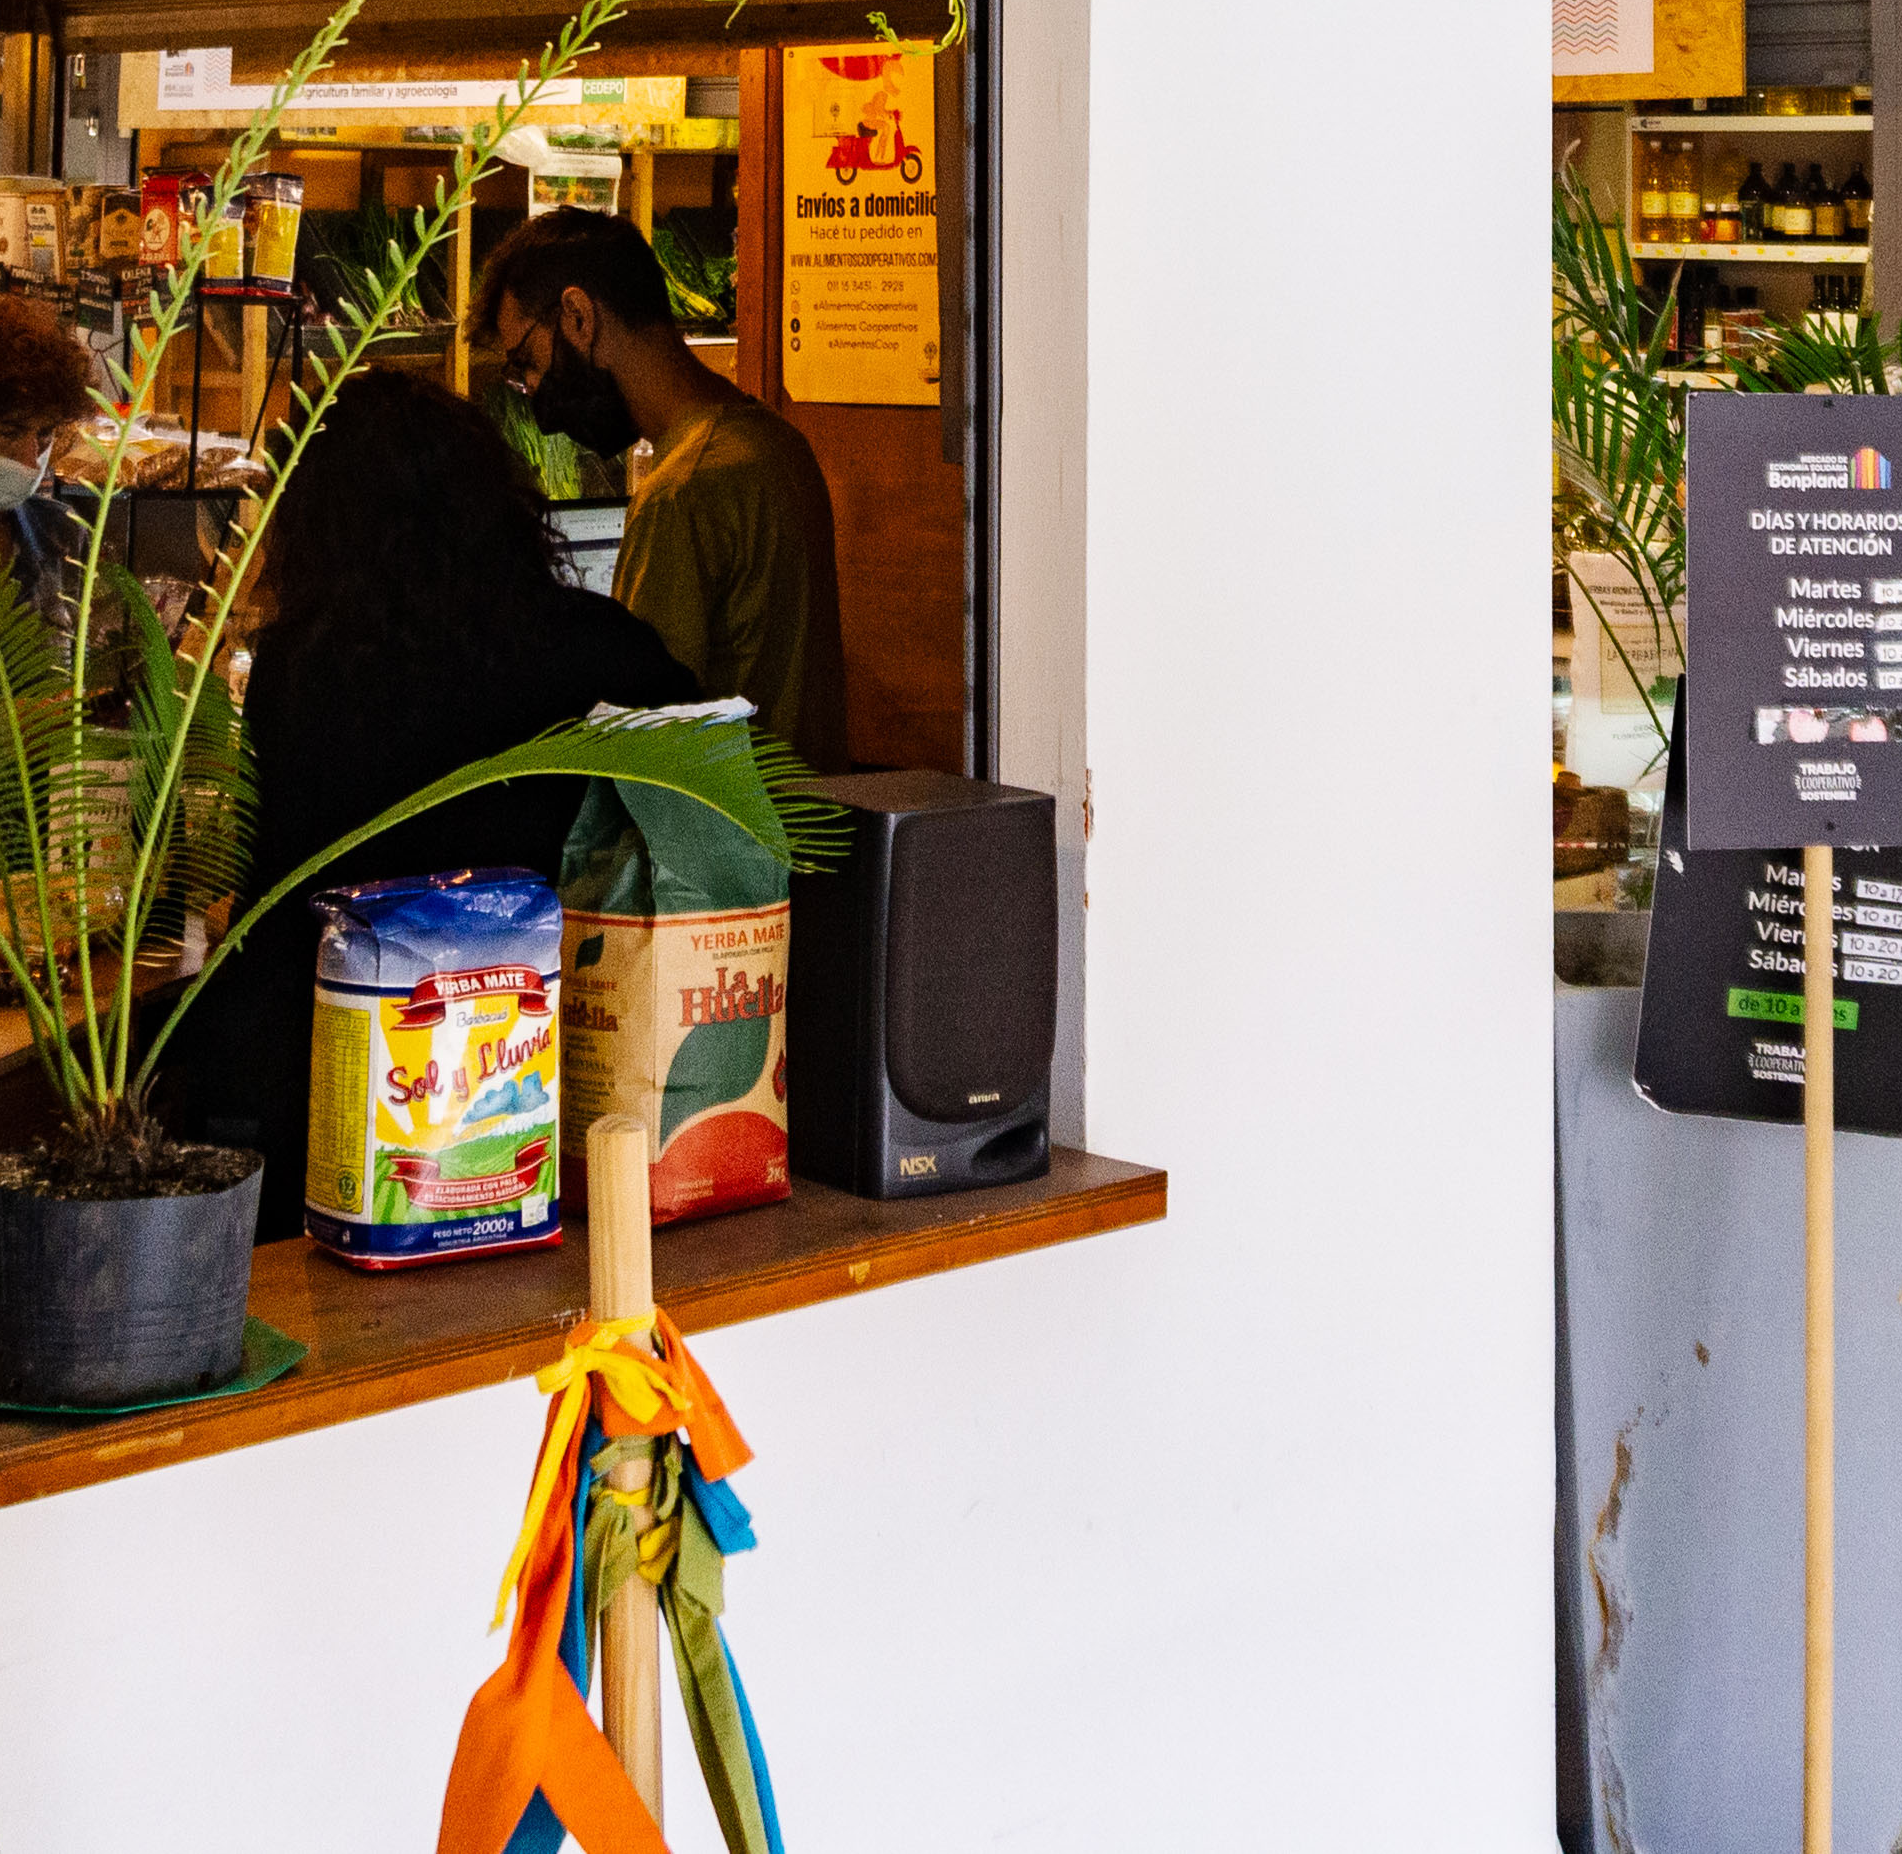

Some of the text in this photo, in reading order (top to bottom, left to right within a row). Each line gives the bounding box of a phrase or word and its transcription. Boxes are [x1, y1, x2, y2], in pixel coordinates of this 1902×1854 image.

[351, 84, 383, 98] familiar
[387, 87, 393, 99] y
[396, 84, 458, 99] agroecología
[583, 80, 624, 96] CEDEPO
[797, 192, 846, 218] Envíos
[850, 196, 860, 218] a
[809, 224, 923, 242] Hacé tu pedido en
[1768, 471, 1849, 492] Bonpland
[1751, 509, 1794, 531] DÍAS
[1796, 512, 1811, 531] Y
[1771, 533, 1892, 556] DE ATENCIÓN
[1790, 578, 1863, 599] Martes
[1777, 608, 1875, 628] Miércoles
[1787, 637, 1864, 658] Viernes
[1883, 647, 1897, 659] 10
[1784, 667, 1868, 688] Sábados
[1883, 674, 1897, 686] 10
[1800, 763, 1857, 775] TRABAJO
[1801, 776, 1857, 790] COOPERATIVO
[1800, 791, 1857, 801] SOSTENIBLE
[1864, 884, 1879, 895] 10
[1863, 910, 1879, 922] 10
[691, 923, 785, 952] YERBA MATE
[1850, 937, 1865, 950] 10
[1878, 939, 1899, 955] 20
[716, 967, 749, 994] La
[1850, 964, 1865, 978] 10
[1878, 968, 1900, 980] 20
[434, 972, 526, 996] YERBA MATE
[679, 972, 785, 1028] Huella
[1738, 998, 1760, 1013] de
[1766, 998, 1788, 1014] 10
[1790, 1003, 1801, 1015] a
[1755, 1043, 1806, 1059] TRABAJ
[387, 1026, 553, 1106] Sol y Lluvia
[968, 1092, 1000, 1105] aiwa
[900, 1155, 937, 1176] NSX
[435, 1176, 518, 1195] ELABORADA CON PALO
[433, 1228, 452, 1239] PESO
[453, 1226, 473, 1237] NETO
